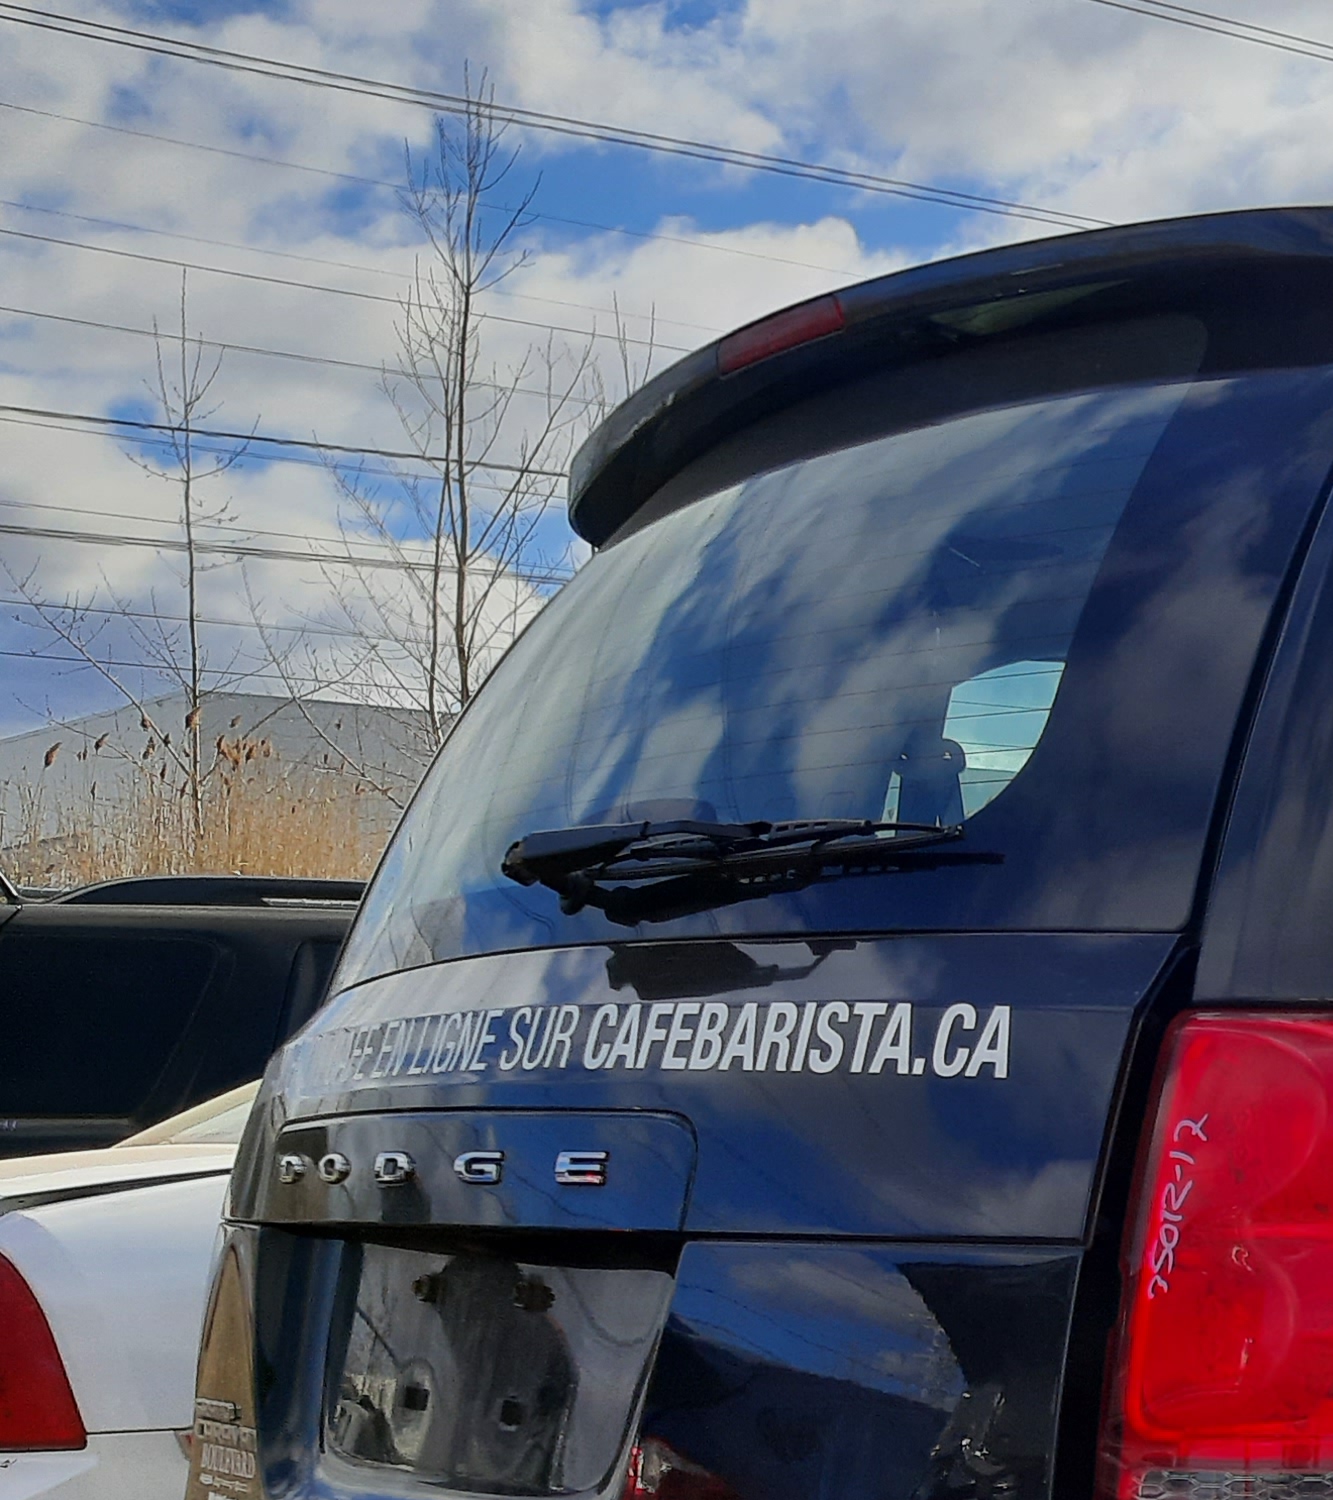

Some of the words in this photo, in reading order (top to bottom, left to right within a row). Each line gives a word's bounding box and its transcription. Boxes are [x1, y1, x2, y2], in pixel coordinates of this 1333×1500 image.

[369, 1019, 416, 1079] EN
[407, 1008, 504, 1077] LIGNE
[499, 1004, 580, 1071] SUR
[583, 1001, 1012, 1079] CAFEBARISTA.CA
[278, 1150, 611, 1187] DODGE
